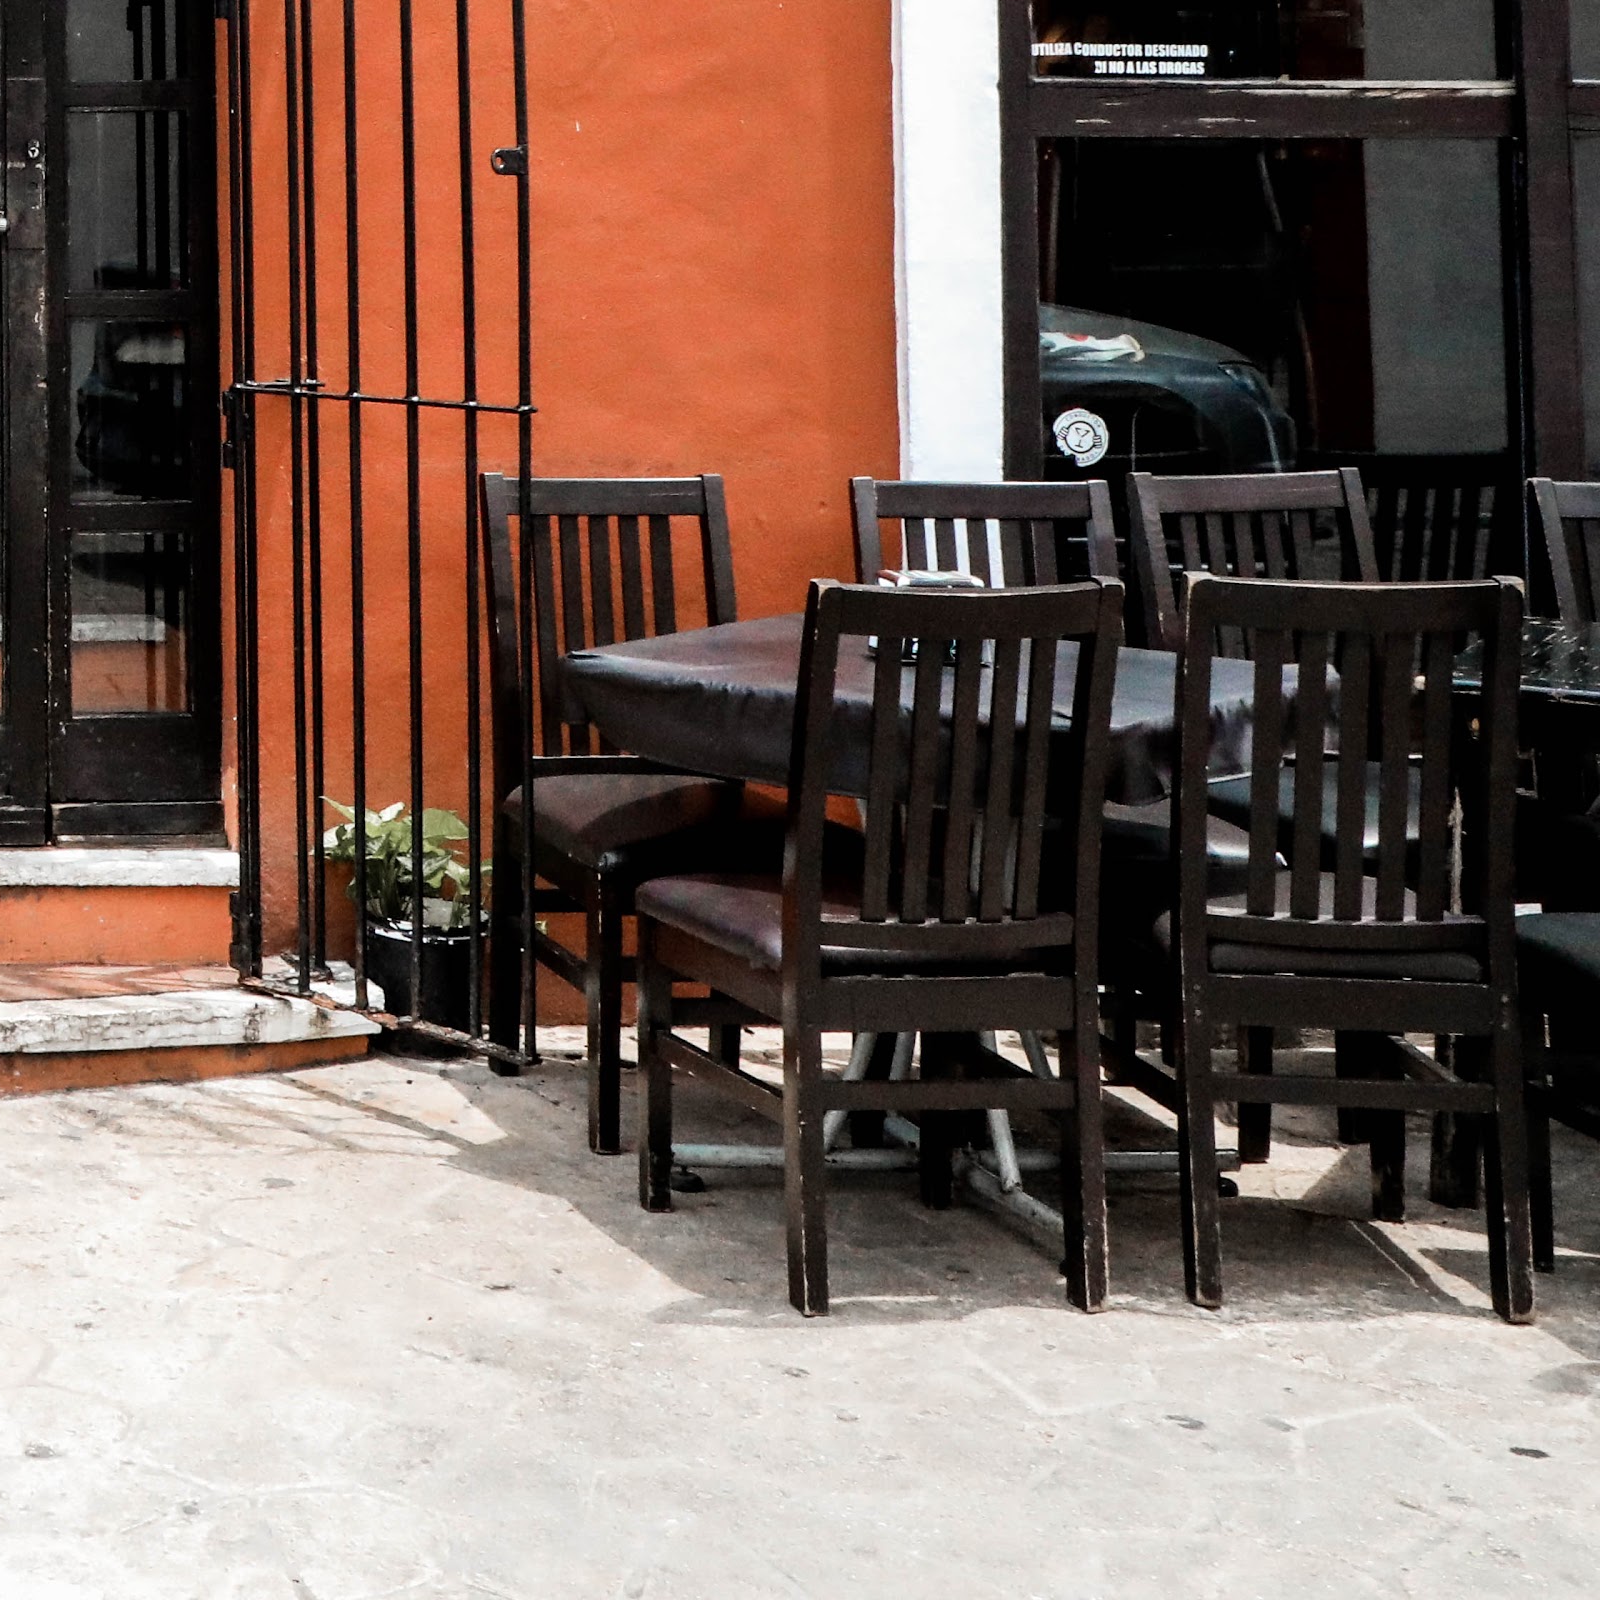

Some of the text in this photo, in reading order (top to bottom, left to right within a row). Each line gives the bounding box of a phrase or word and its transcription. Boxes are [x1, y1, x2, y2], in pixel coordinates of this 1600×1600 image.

[1074, 42, 1142, 57] CONDUCTOR
[1144, 44, 1208, 58] DESIGNADO
[1126, 61, 1135, 74] A
[1136, 62, 1158, 74] LAS
[1159, 62, 1205, 75] DROGAS
